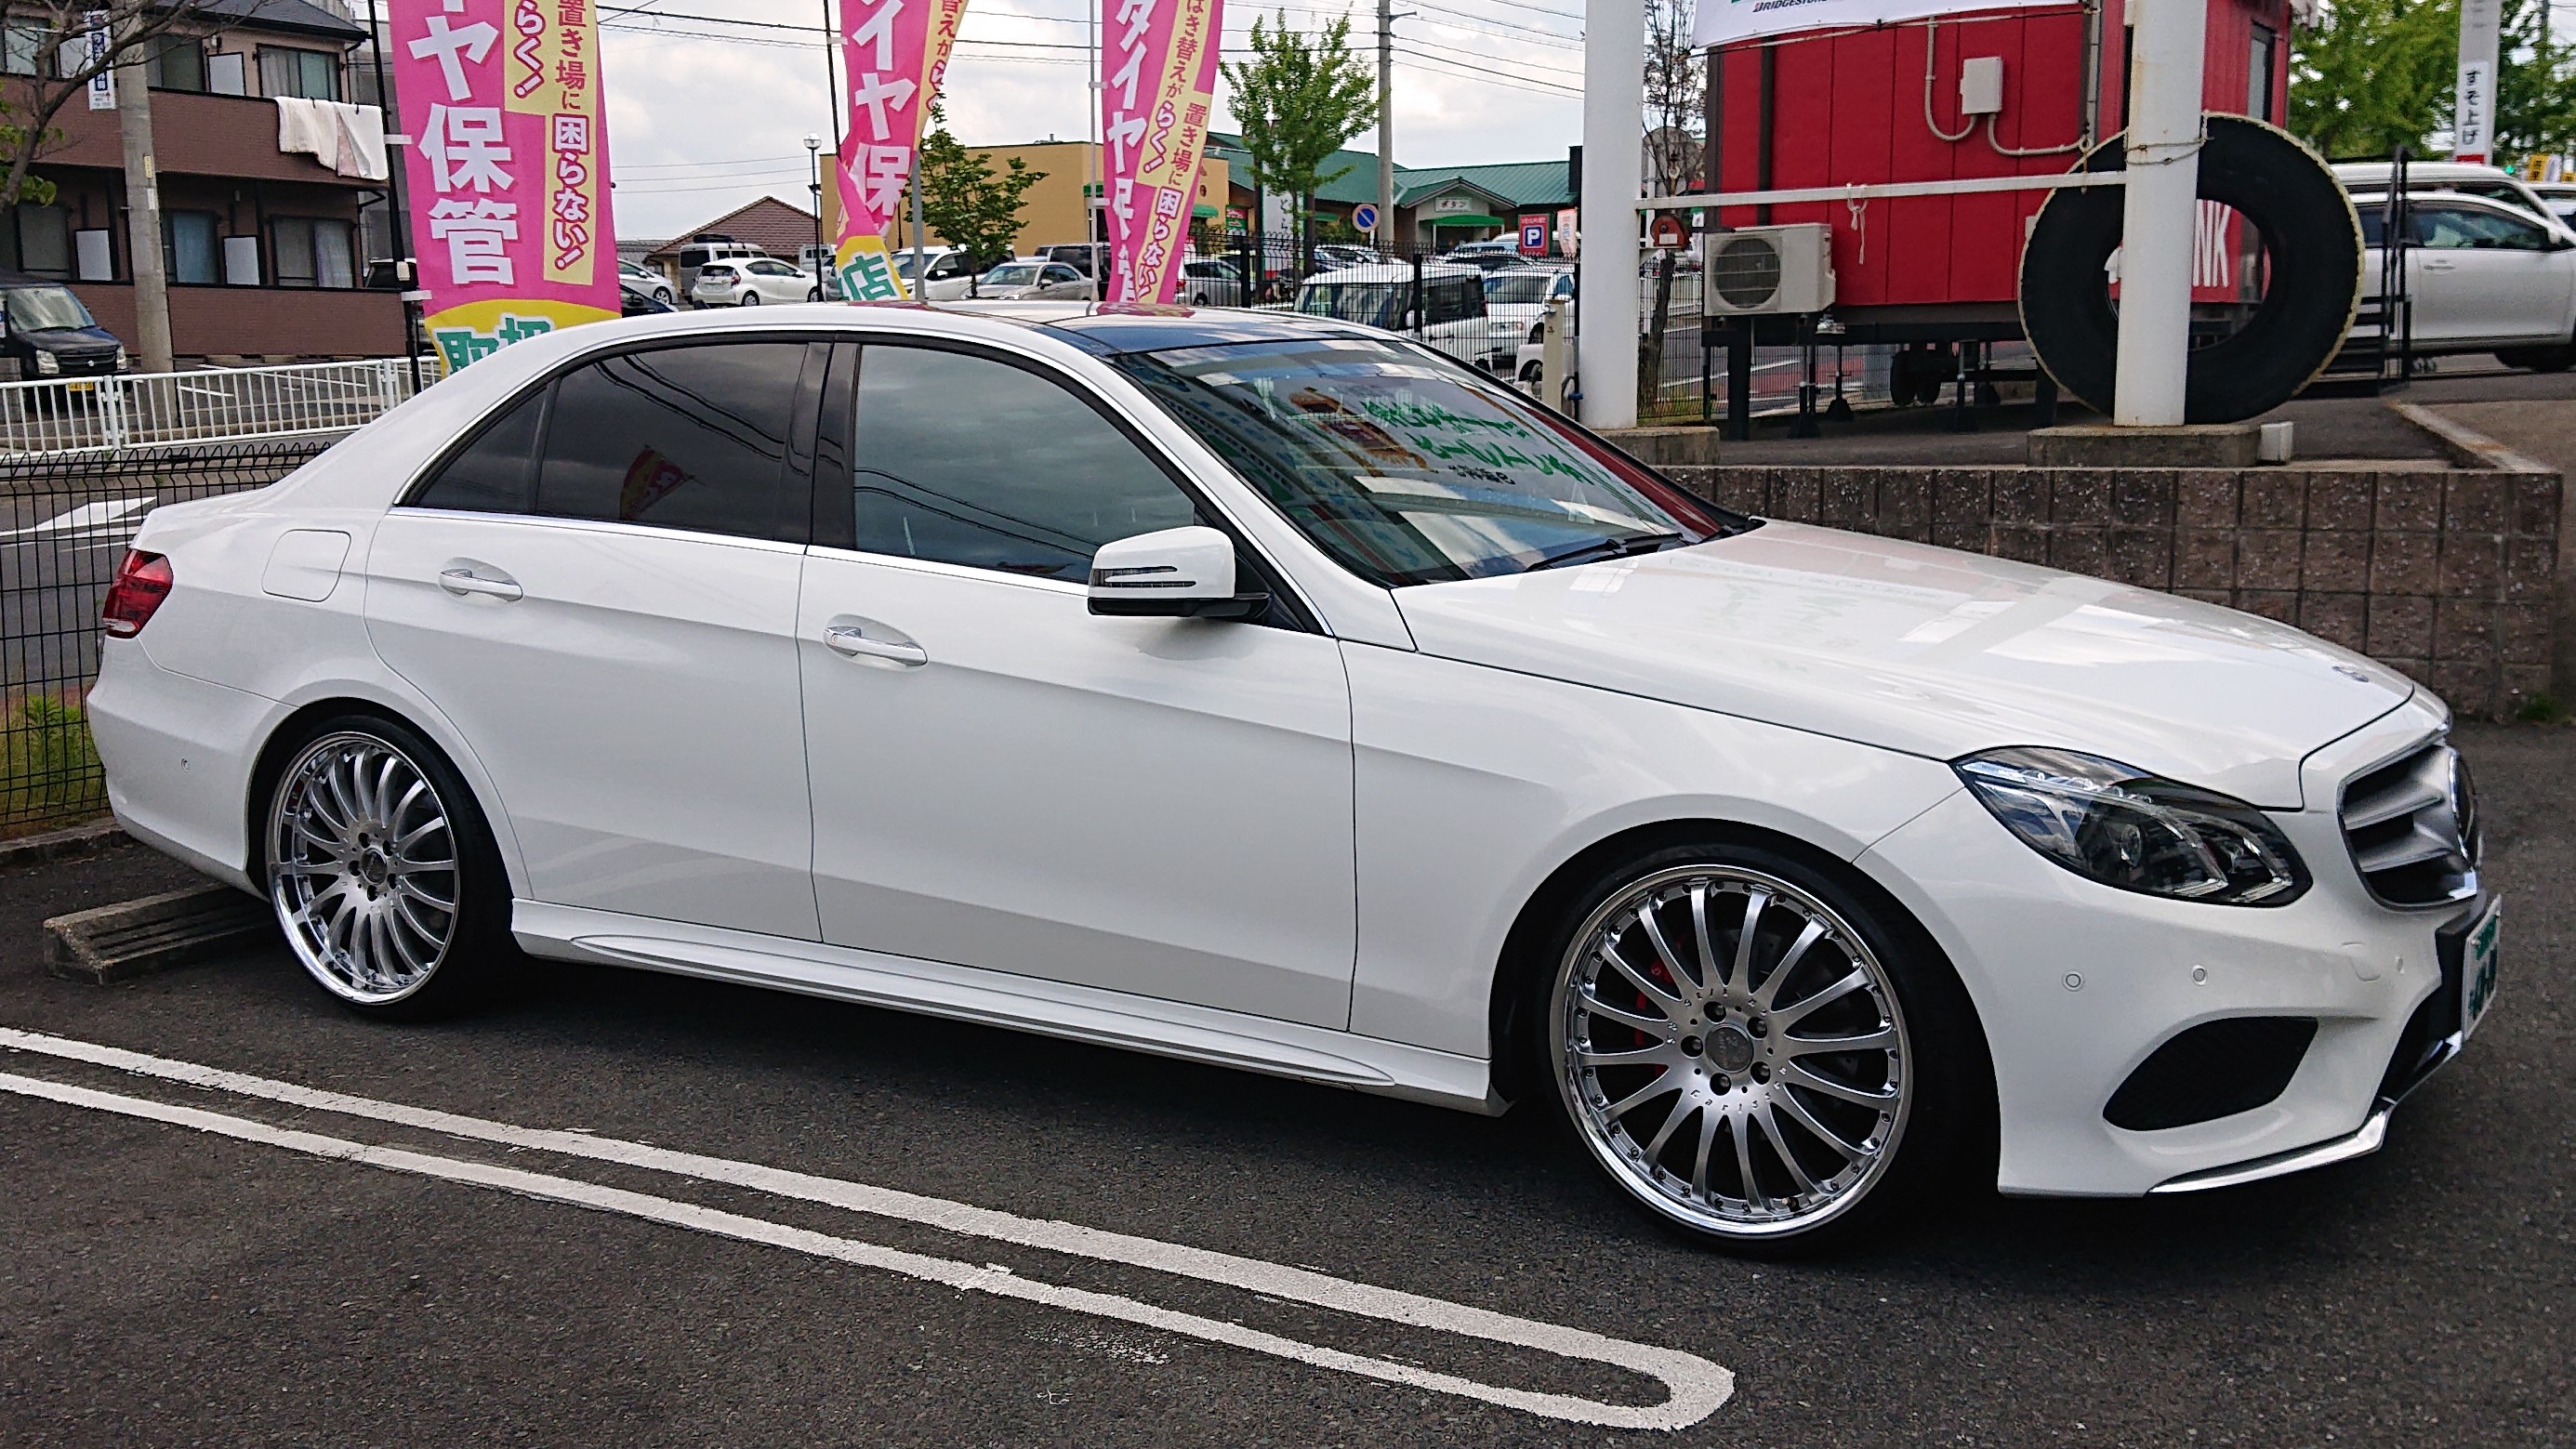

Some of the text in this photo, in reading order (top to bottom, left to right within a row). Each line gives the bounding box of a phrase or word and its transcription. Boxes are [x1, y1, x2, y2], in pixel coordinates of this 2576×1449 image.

[1752, 0, 1828, 12] BRIDGEST
[406, 0, 519, 284] ヤ保管
[848, 0, 917, 216] イヤ保
[1526, 229, 1540, 245] P
